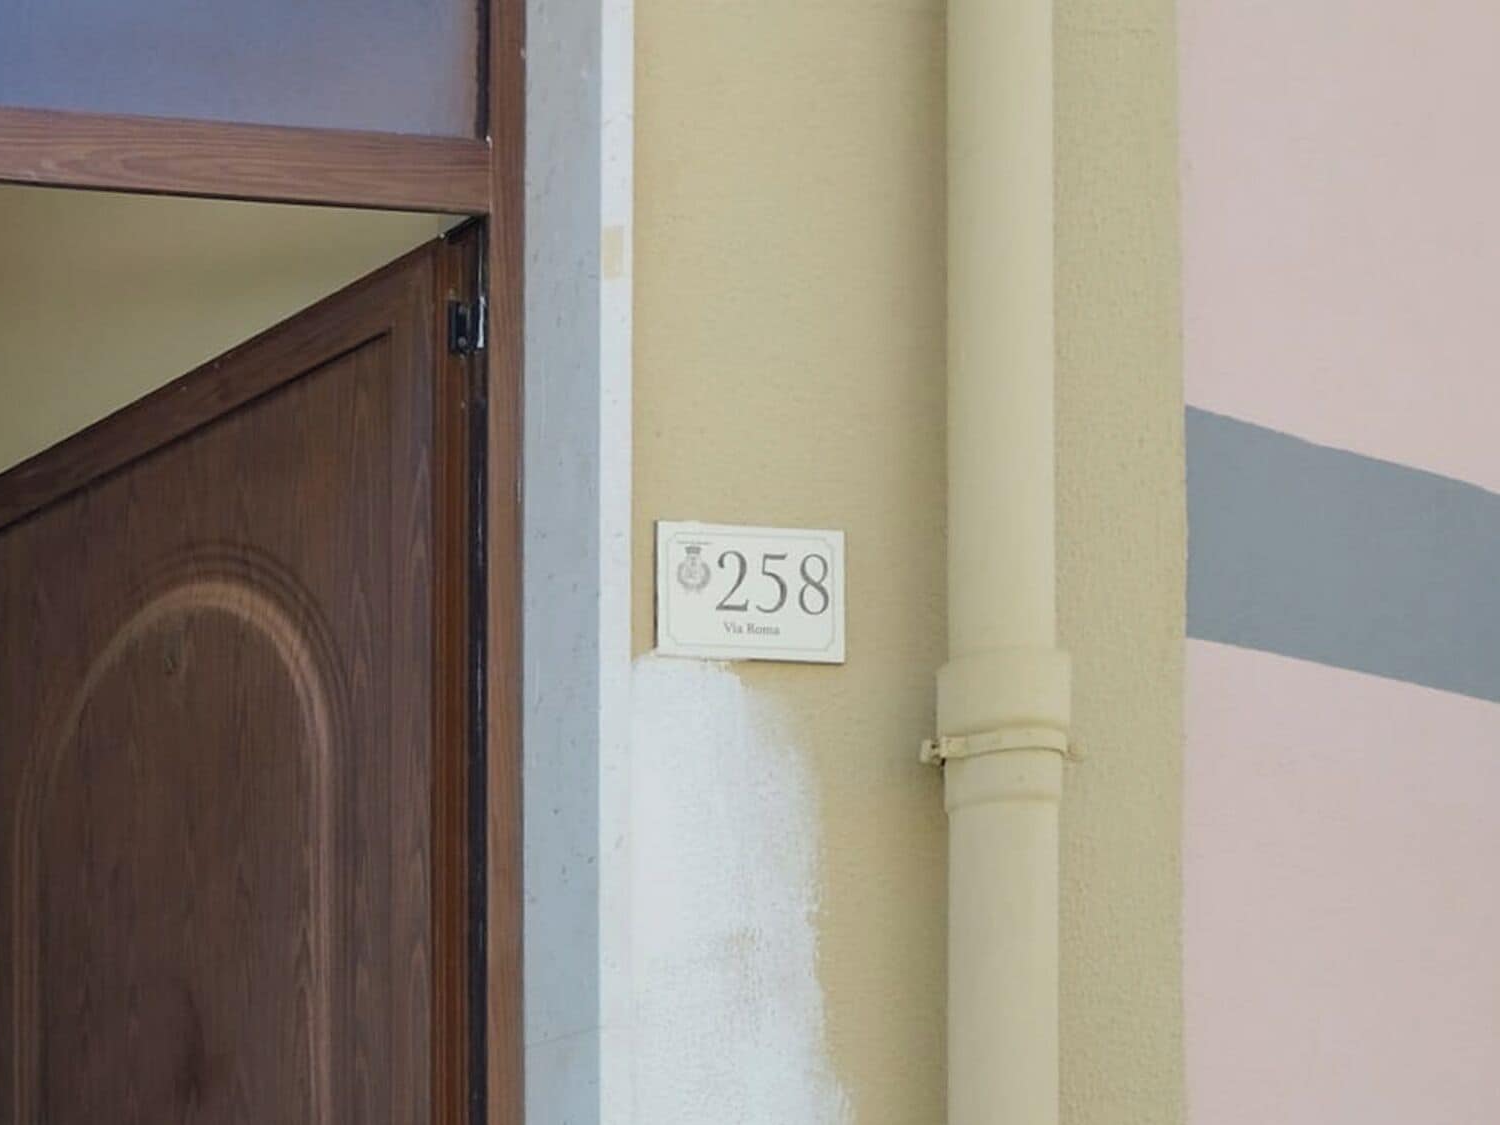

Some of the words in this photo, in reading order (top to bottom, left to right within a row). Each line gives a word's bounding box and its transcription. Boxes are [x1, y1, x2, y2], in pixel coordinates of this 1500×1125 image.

[715, 550, 830, 615] 258
[723, 622, 743, 634] Via
[747, 623, 780, 635] Roma
